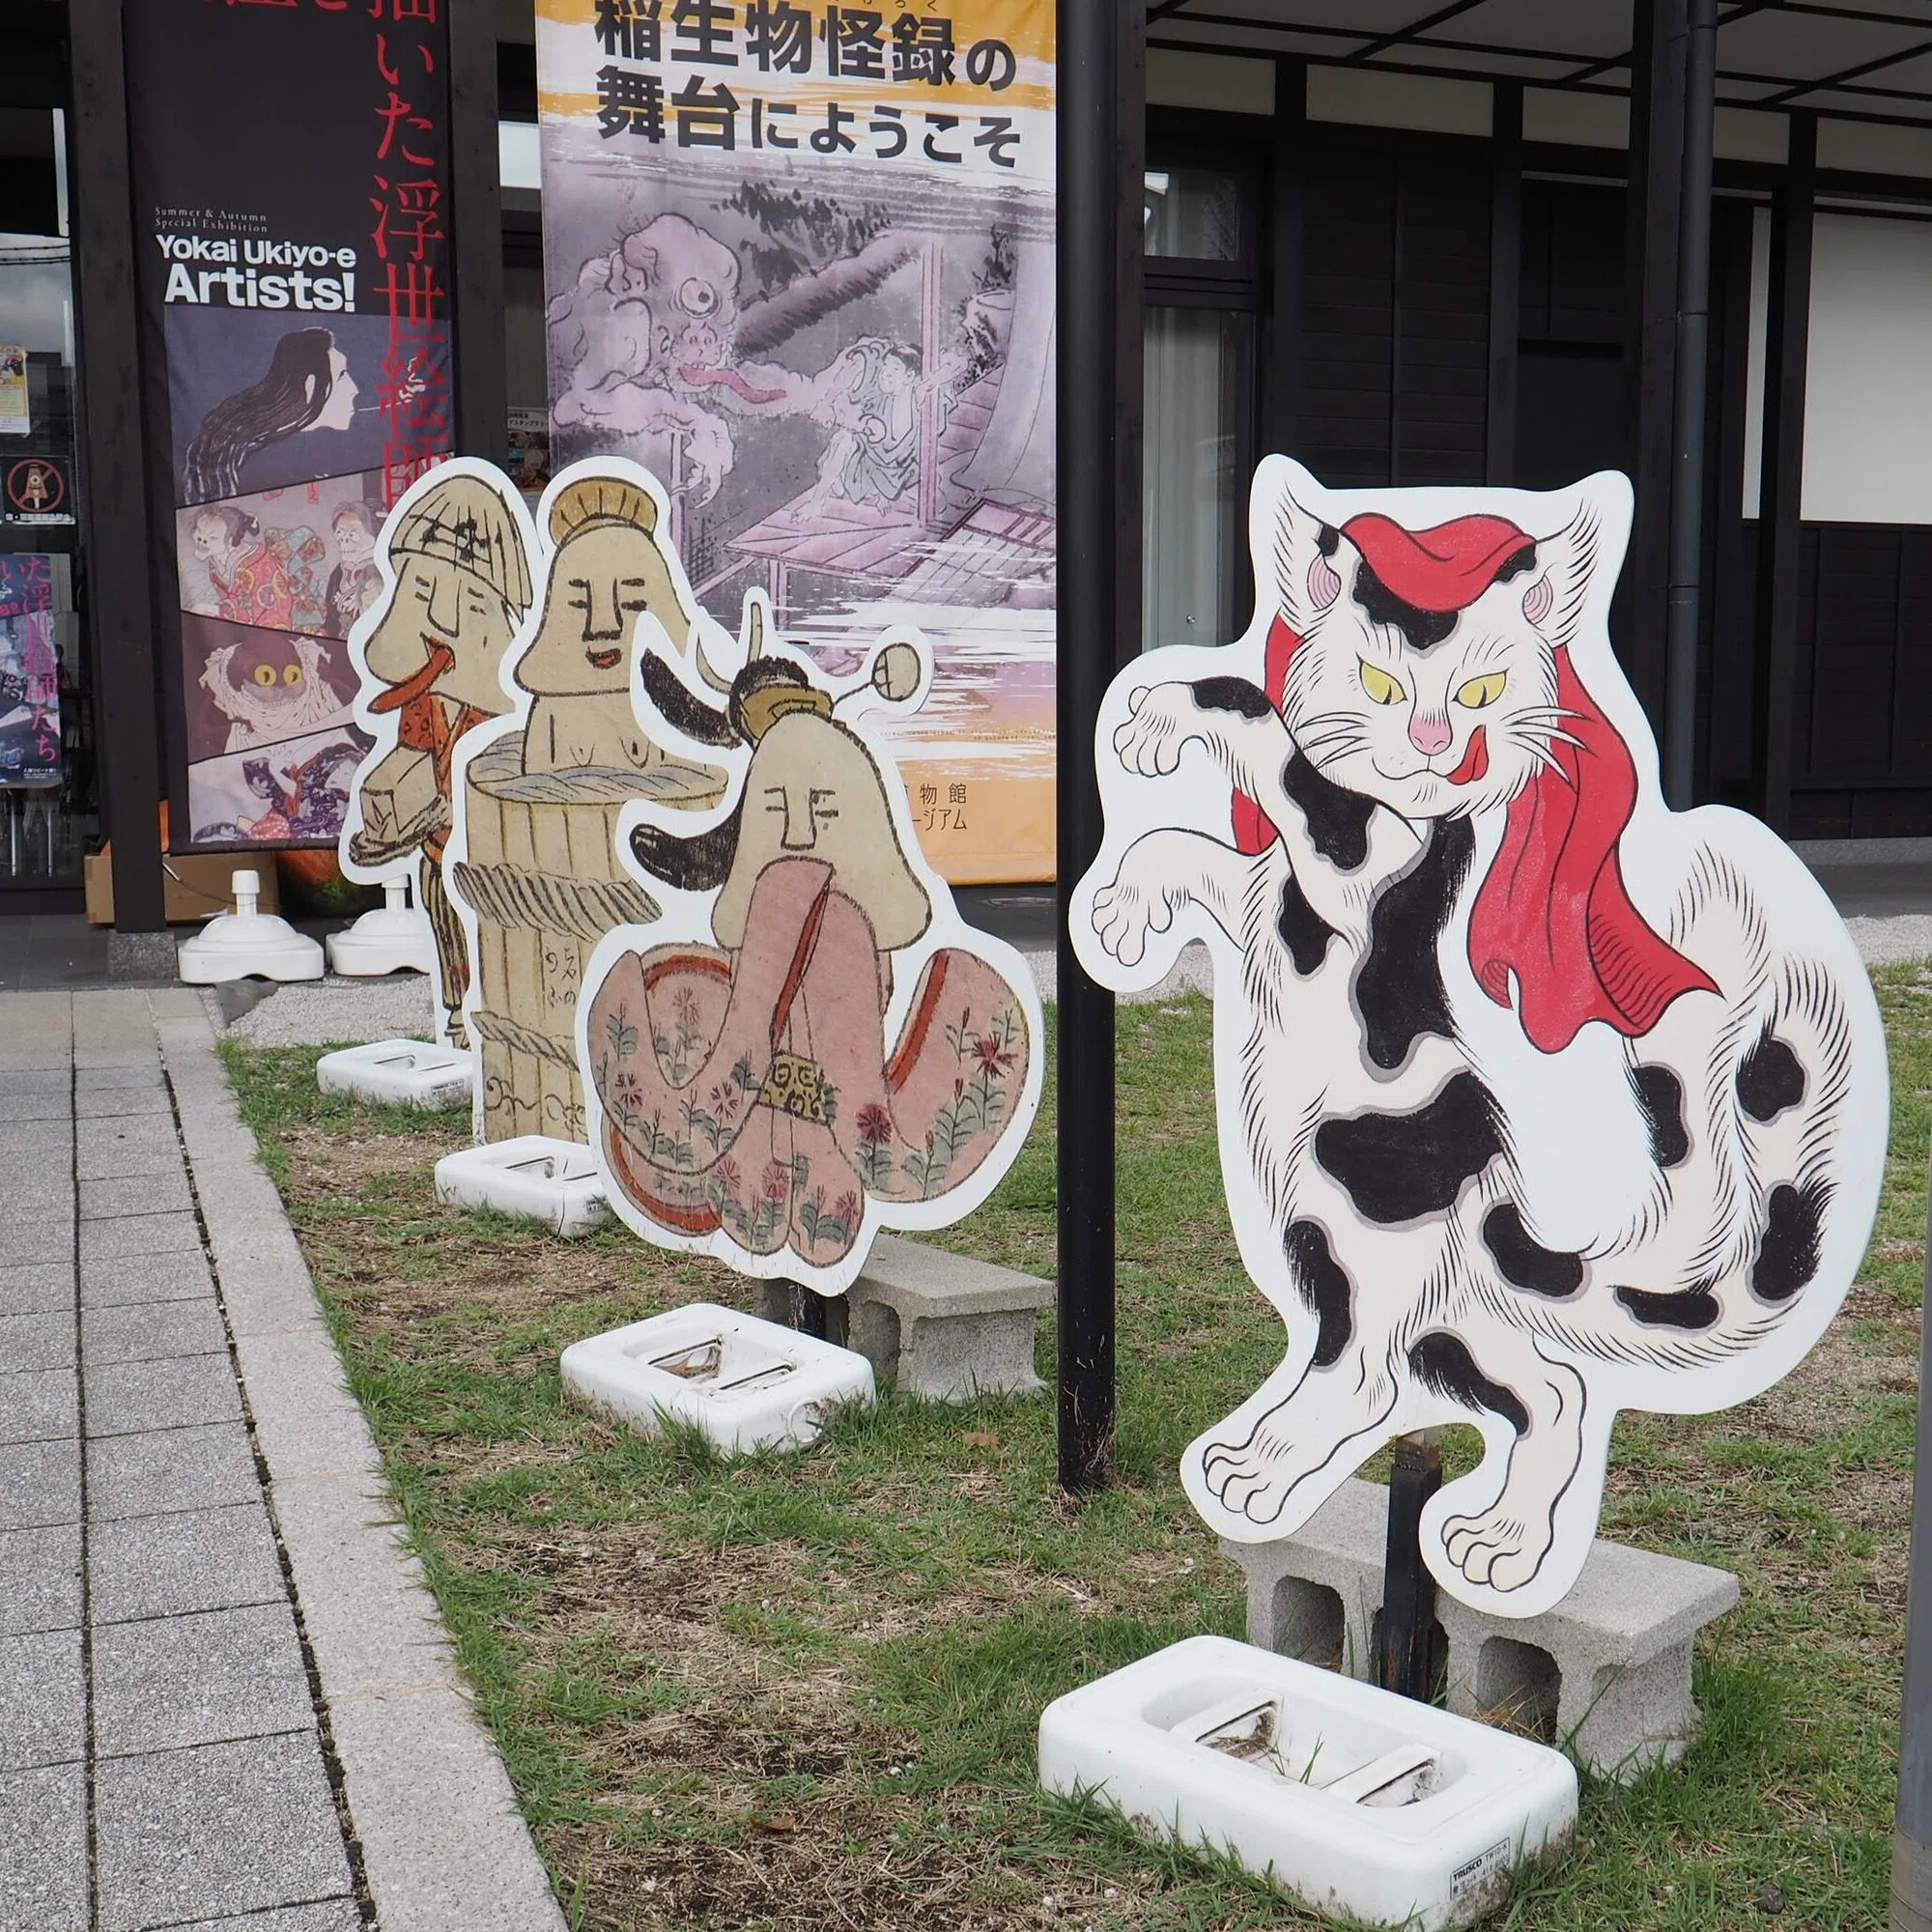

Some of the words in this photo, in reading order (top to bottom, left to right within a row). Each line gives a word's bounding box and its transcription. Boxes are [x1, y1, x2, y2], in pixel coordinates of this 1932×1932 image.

[594, 0, 1017, 92] 稲生物怪録の
[596, 65, 1022, 168] 舞台にようこそ
[155, 207, 201, 217] Summer
[205, 209, 214, 218] &
[218, 210, 267, 222] Autumn
[155, 217, 197, 230] Special
[202, 219, 269, 233] Exhibition
[156, 234, 238, 262] Yokai
[243, 239, 356, 268] Ukiyo-e
[164, 263, 355, 312] Artists!
[904, 782, 967, 805] 物館
[1453, 1859, 1483, 1881] TRUSCO
